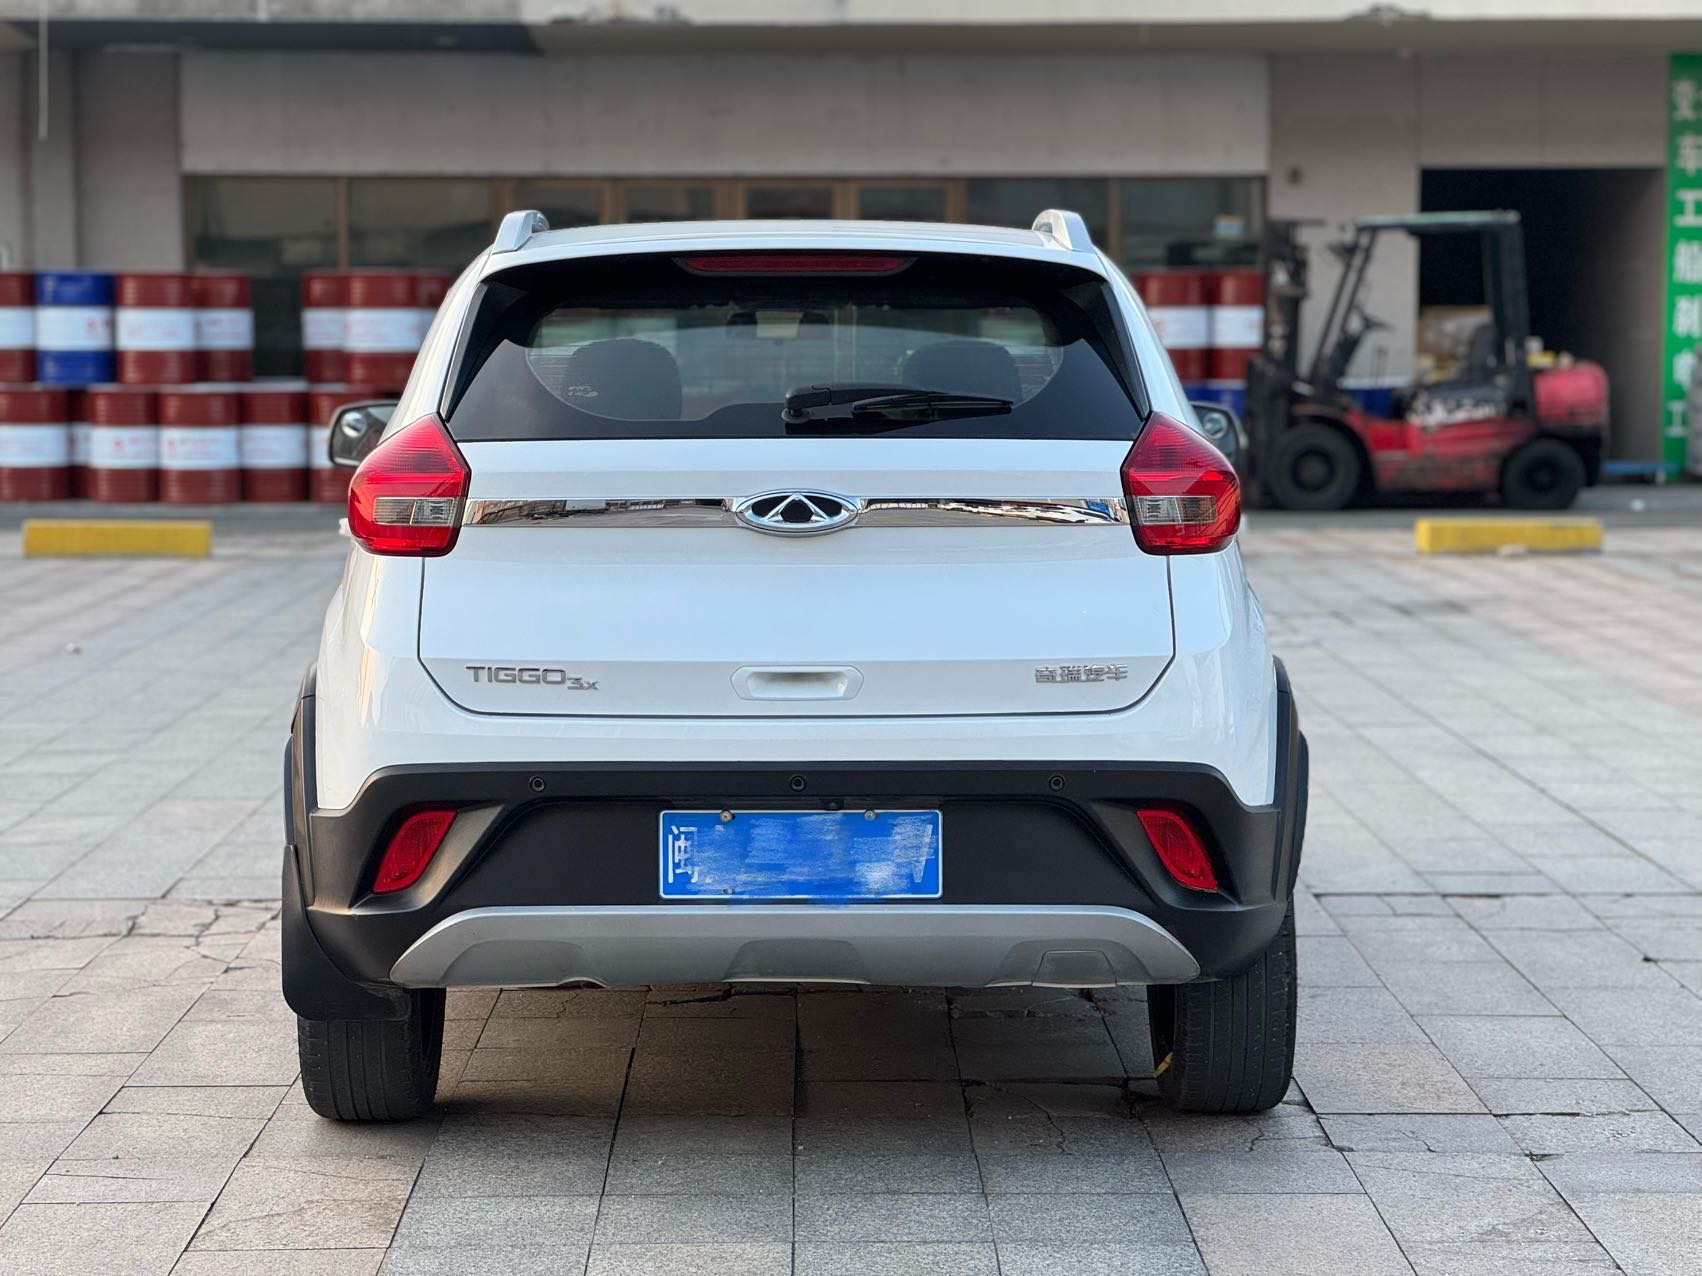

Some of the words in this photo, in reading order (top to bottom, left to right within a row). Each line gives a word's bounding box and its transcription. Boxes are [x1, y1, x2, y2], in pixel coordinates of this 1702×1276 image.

[465, 666, 567, 685] TIGGO
[1034, 664, 1129, 684] 奇瑞汽车
